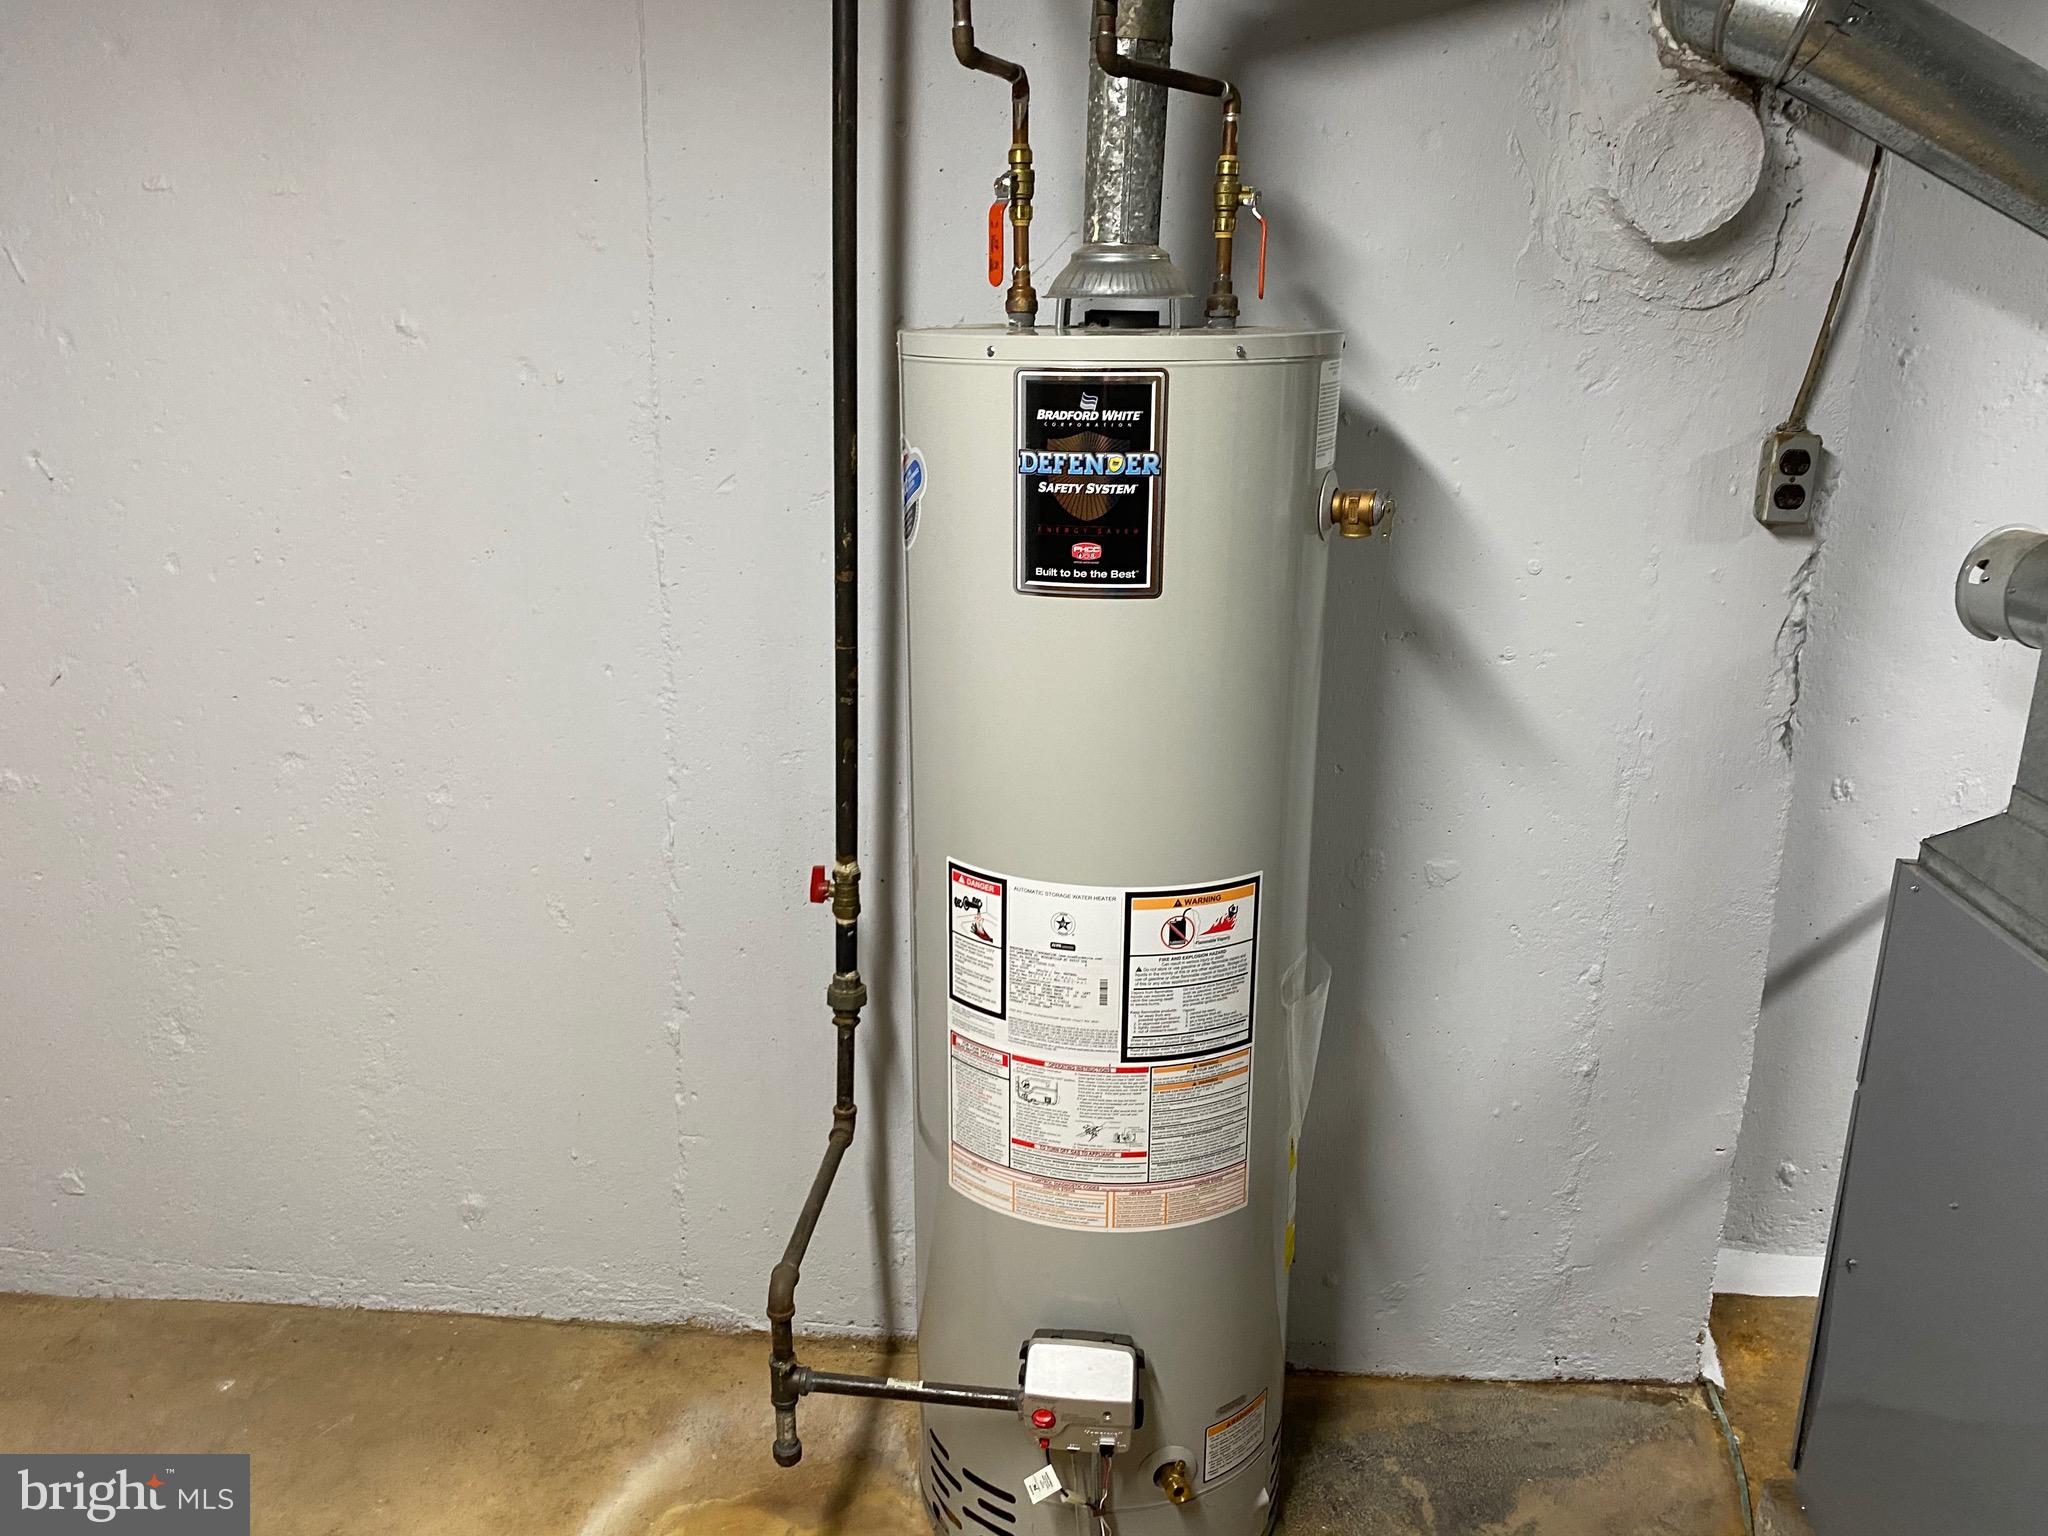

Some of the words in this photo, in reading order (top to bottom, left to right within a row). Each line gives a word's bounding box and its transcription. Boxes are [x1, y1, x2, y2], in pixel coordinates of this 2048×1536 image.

[1037, 409, 1099, 421] BRADFORD
[1102, 410, 1141, 421] WHITE
[1019, 450, 1161, 475] DEFENDER
[1038, 482, 1083, 493] SAFETY
[1085, 483, 1136, 494] SYSTEM
[1036, 568, 1058, 576] Built
[1060, 569, 1070, 577] to
[1074, 569, 1087, 578] be
[1090, 570, 1108, 578] the
[1111, 570, 1136, 578] Best
[966, 878, 994, 893] DANGER
[1014, 886, 1044, 896] AUTOMATIC
[1184, 895, 1221, 905] WARNING
